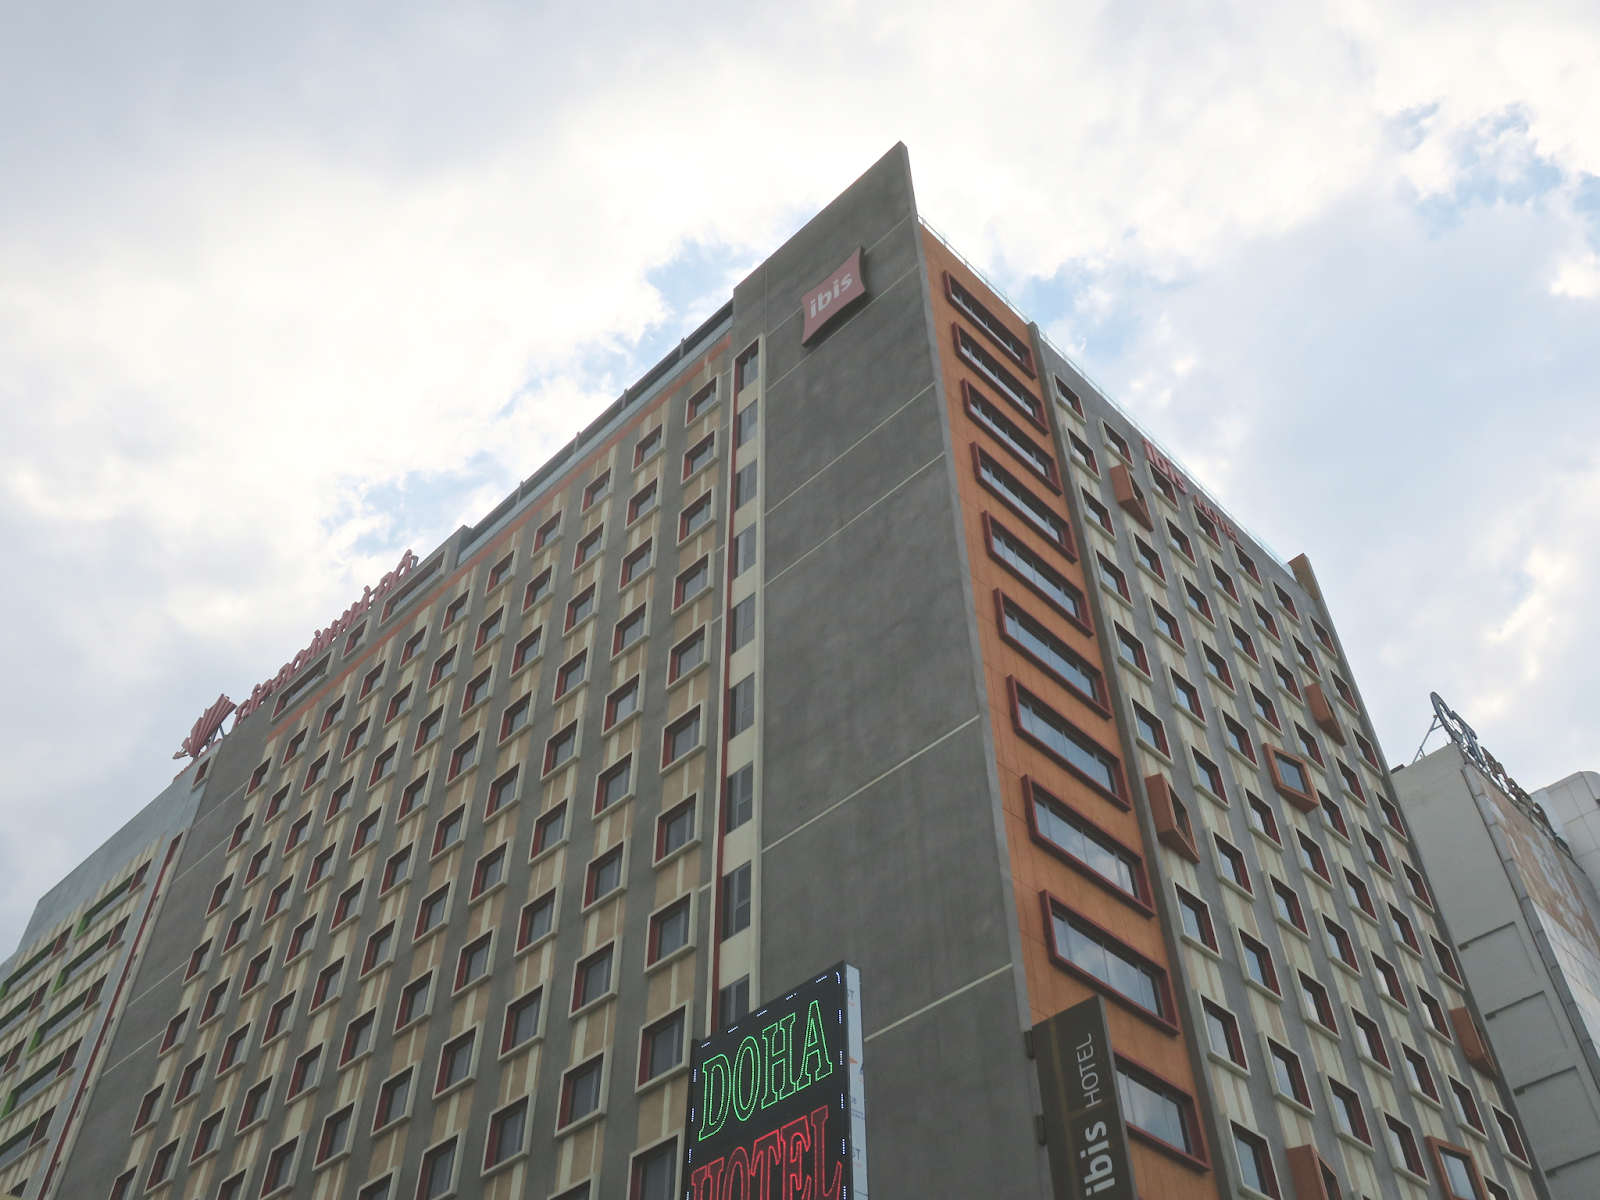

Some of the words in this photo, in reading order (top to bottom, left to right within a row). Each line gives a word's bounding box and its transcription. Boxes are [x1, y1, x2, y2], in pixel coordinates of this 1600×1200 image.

[810, 272, 853, 319] ibis
[1142, 437, 1189, 495] ibis
[1193, 494, 1245, 551] HOTEL
[698, 999, 833, 1142] DOHA
[1075, 1032, 1102, 1109] HOTEL
[1079, 1120, 1116, 1197] ibis
